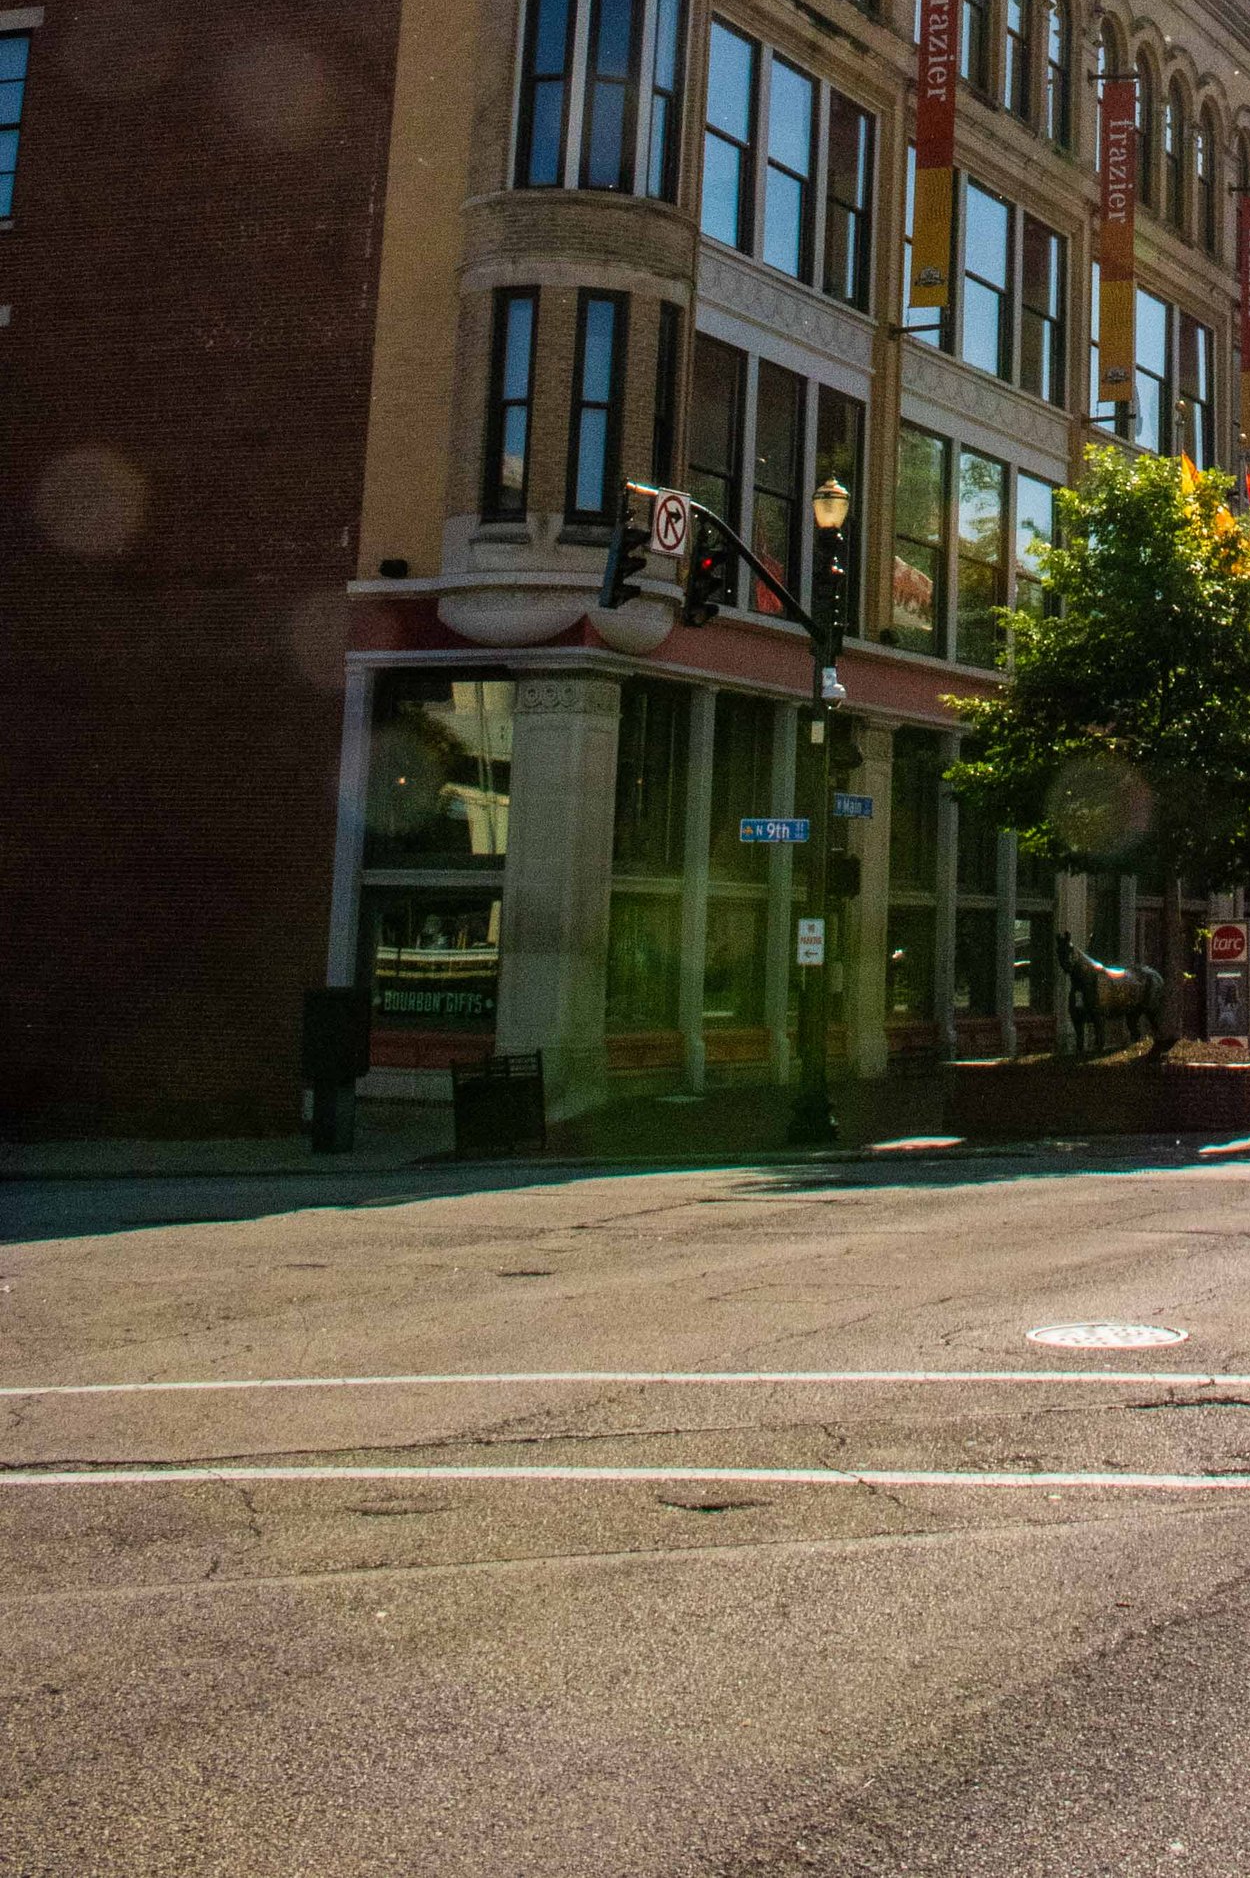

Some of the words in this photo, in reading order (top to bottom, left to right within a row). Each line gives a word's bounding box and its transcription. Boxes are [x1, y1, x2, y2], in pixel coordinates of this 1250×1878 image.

[1108, 119, 1134, 224] frazier
[843, 797, 862, 814] Main
[756, 824, 763, 836] N
[766, 822, 790, 839] 9th
[1213, 935, 1243, 951] tarc
[384, 989, 441, 1012] BOURBON
[446, 991, 482, 1014] GIFTS
